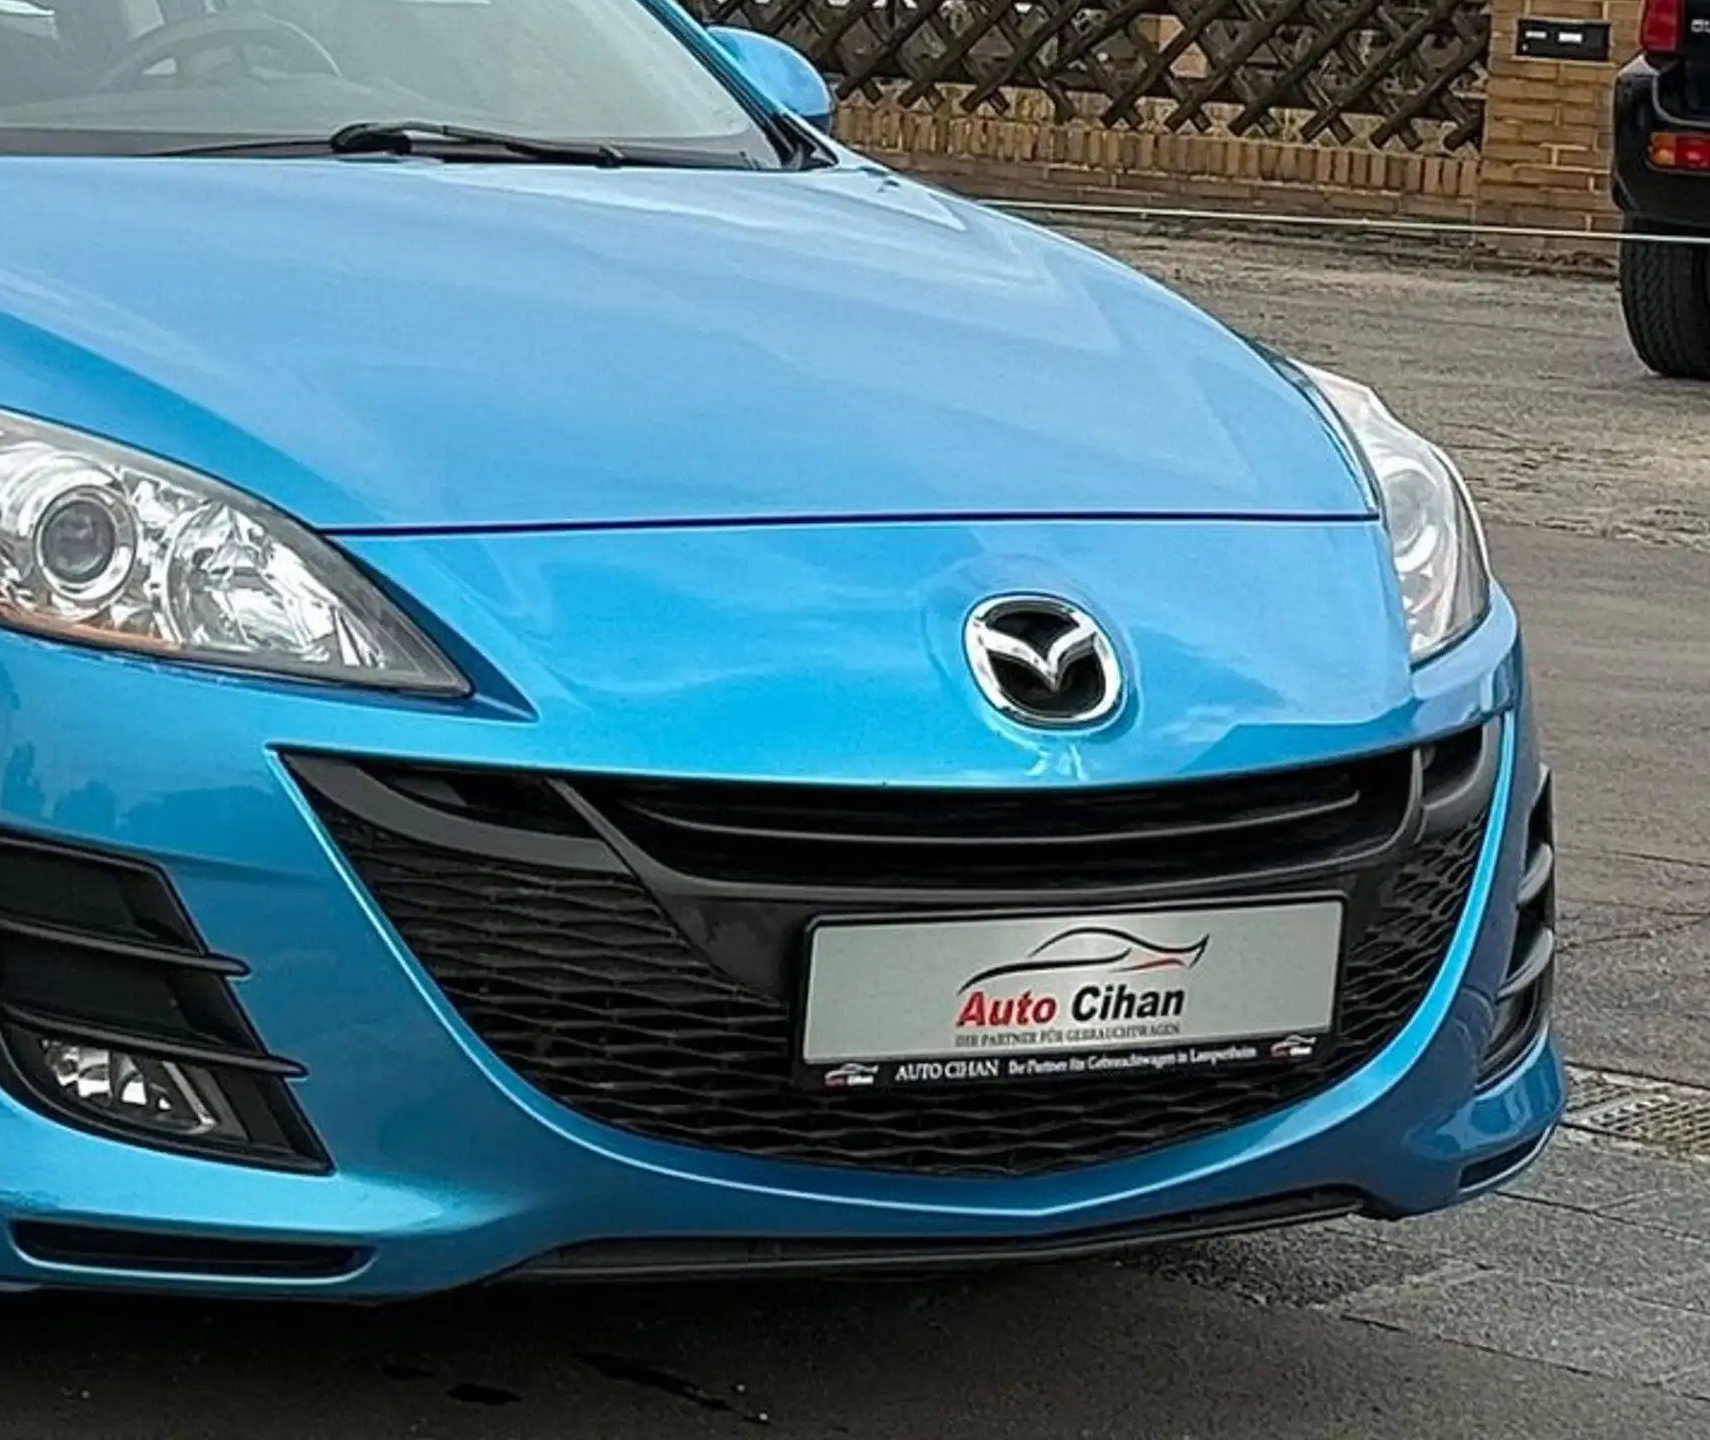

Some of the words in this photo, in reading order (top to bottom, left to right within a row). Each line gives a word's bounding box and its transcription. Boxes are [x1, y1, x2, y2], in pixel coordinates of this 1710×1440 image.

[955, 988, 1058, 1028] Auto
[1071, 984, 1185, 1022] Cihan
[894, 1062, 943, 1082] AUTO
[944, 1058, 999, 1079] CIHAN
